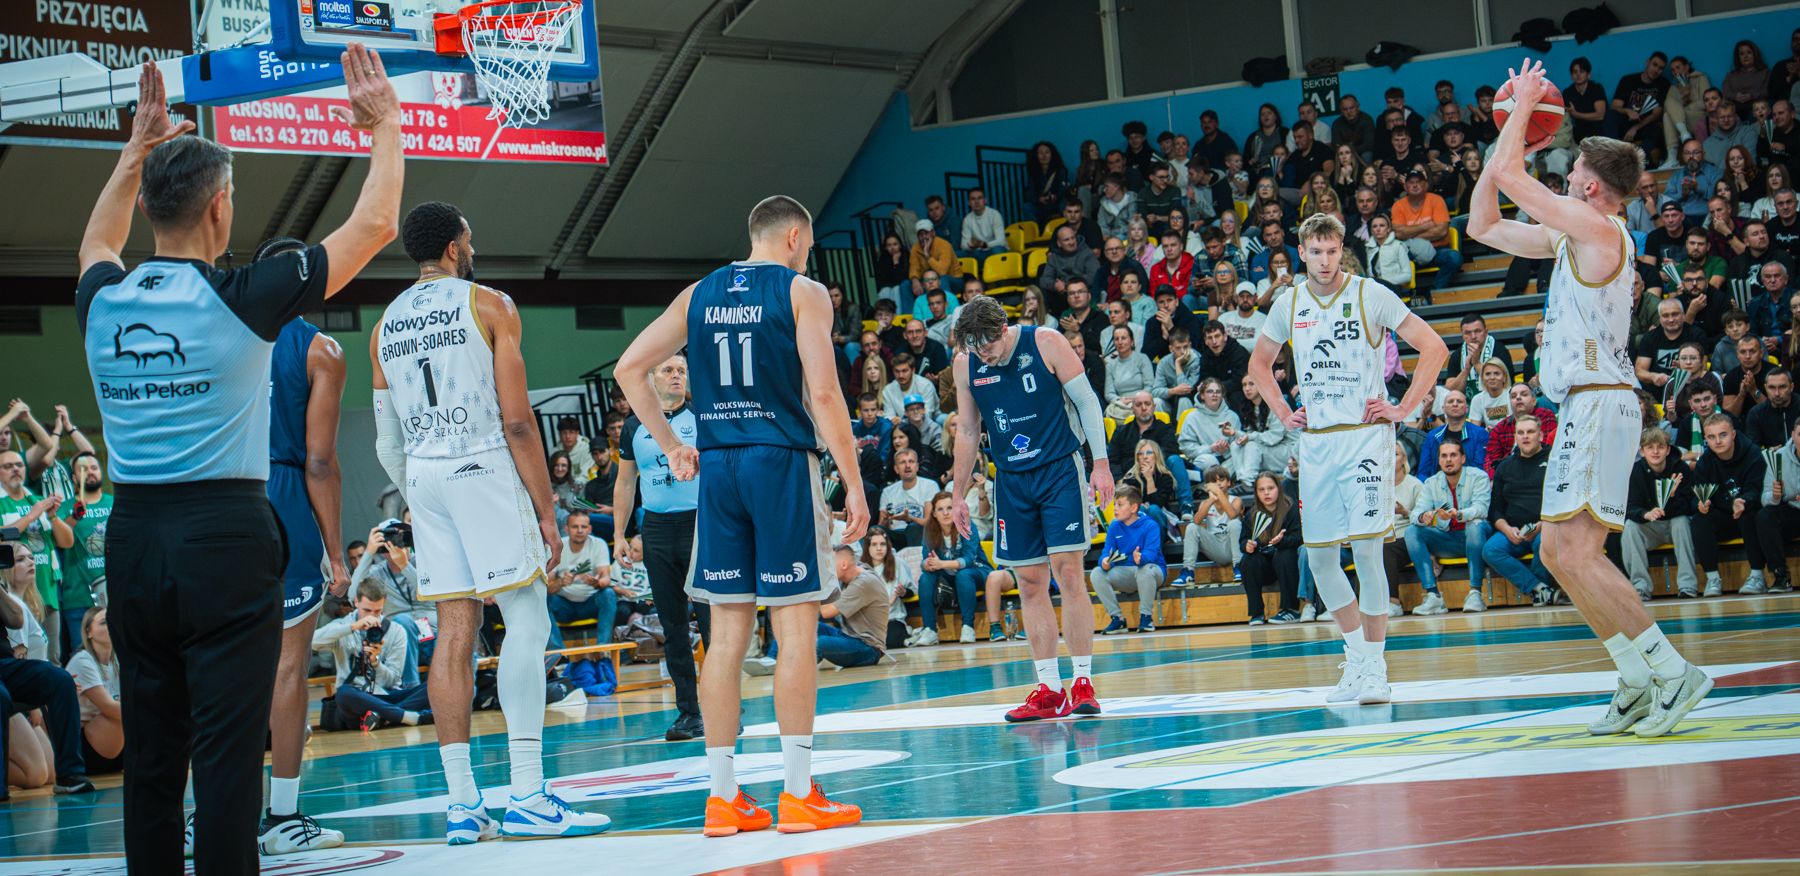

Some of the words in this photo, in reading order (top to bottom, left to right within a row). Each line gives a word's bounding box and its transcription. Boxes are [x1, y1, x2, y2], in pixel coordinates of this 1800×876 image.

[320, 1, 351, 14] molten
[35, 0, 149, 33] PRZYJĘCIA
[1303, 76, 1338, 89] SEKTOR
[1310, 90, 1337, 115] A1
[305, 105, 325, 121] ul.
[416, 109, 435, 127] 78
[437, 114, 448, 128] c
[278, 129, 298, 145] 43
[301, 130, 329, 146] 270
[332, 132, 357, 150] 46,
[400, 134, 423, 150] 601
[427, 136, 454, 152] 424
[457, 137, 481, 152] 507
[497, 139, 606, 159] www.miskrosno.pl
[138, 275, 164, 290] 4F
[704, 304, 763, 325] KAMIŃSKI
[1298, 309, 1311, 317] 4F
[383, 307, 461, 337] NowyStyl
[1334, 320, 1360, 340] 25
[382, 328, 467, 362] BROWN-SOARES
[714, 332, 754, 387] 11
[1311, 360, 1342, 369] ORLEN
[976, 365, 989, 374] 4F
[100, 382, 140, 400] Bank
[145, 380, 210, 399] Pekao
[418, 357, 438, 407] 1
[1022, 372, 1037, 393] 0
[700, 411, 742, 421] FINANCIAL
[434, 426, 469, 438] SZKŁA
[446, 468, 495, 481] PODKARPACKIE
[1356, 475, 1381, 483] ORLEN
[1557, 483, 1570, 492] 4F
[1363, 509, 1379, 518] 4F
[1065, 522, 1080, 531] 4F
[621, 571, 646, 589] 52
[703, 568, 742, 581] Dantex
